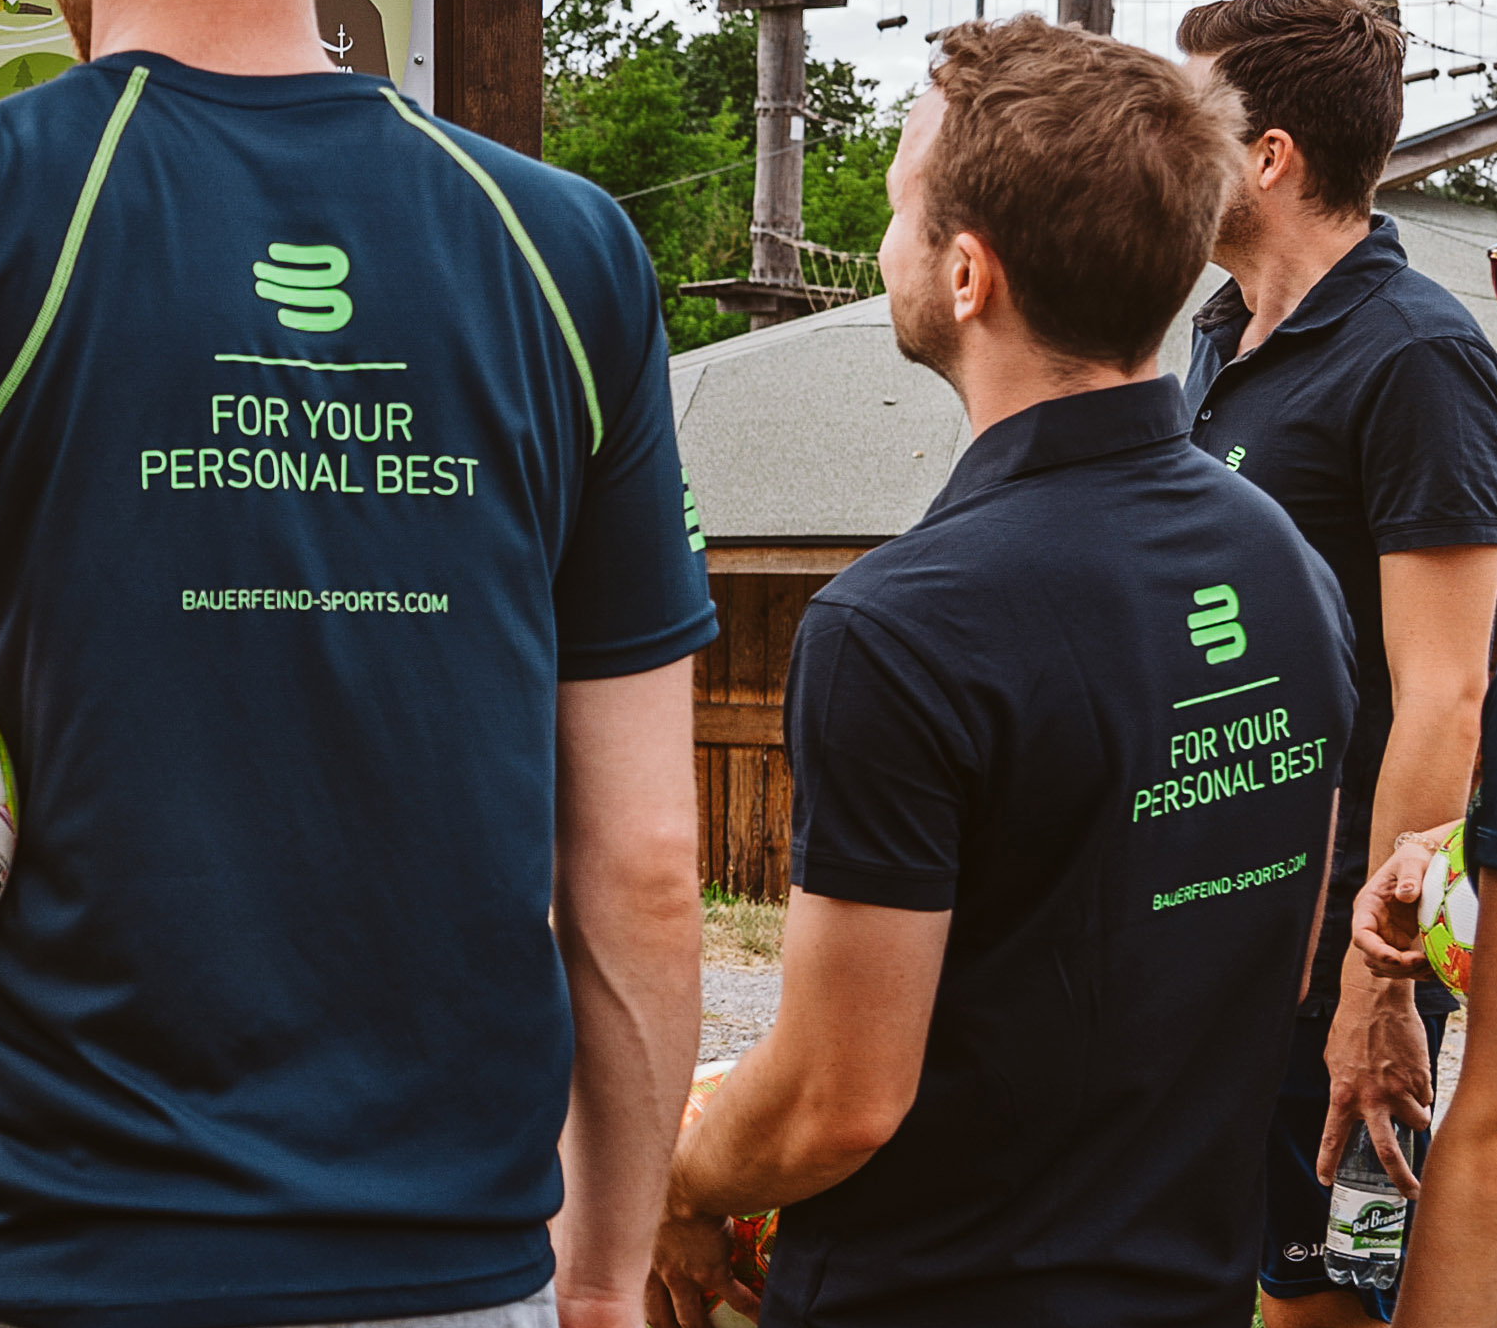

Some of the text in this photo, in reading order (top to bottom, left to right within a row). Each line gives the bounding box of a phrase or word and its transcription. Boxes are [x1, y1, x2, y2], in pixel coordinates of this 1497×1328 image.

[212, 394, 414, 442] FOR YOUR
[141, 448, 479, 497] PERSONAL BEST
[182, 589, 449, 613] BAUERFEIND-SPORTS.COM
[1171, 708, 1291, 769] FOR YOUR
[1133, 738, 1328, 823] PERSONAL BEST
[1152, 852, 1307, 911] BAUERFEIND-SPORTS.COM
